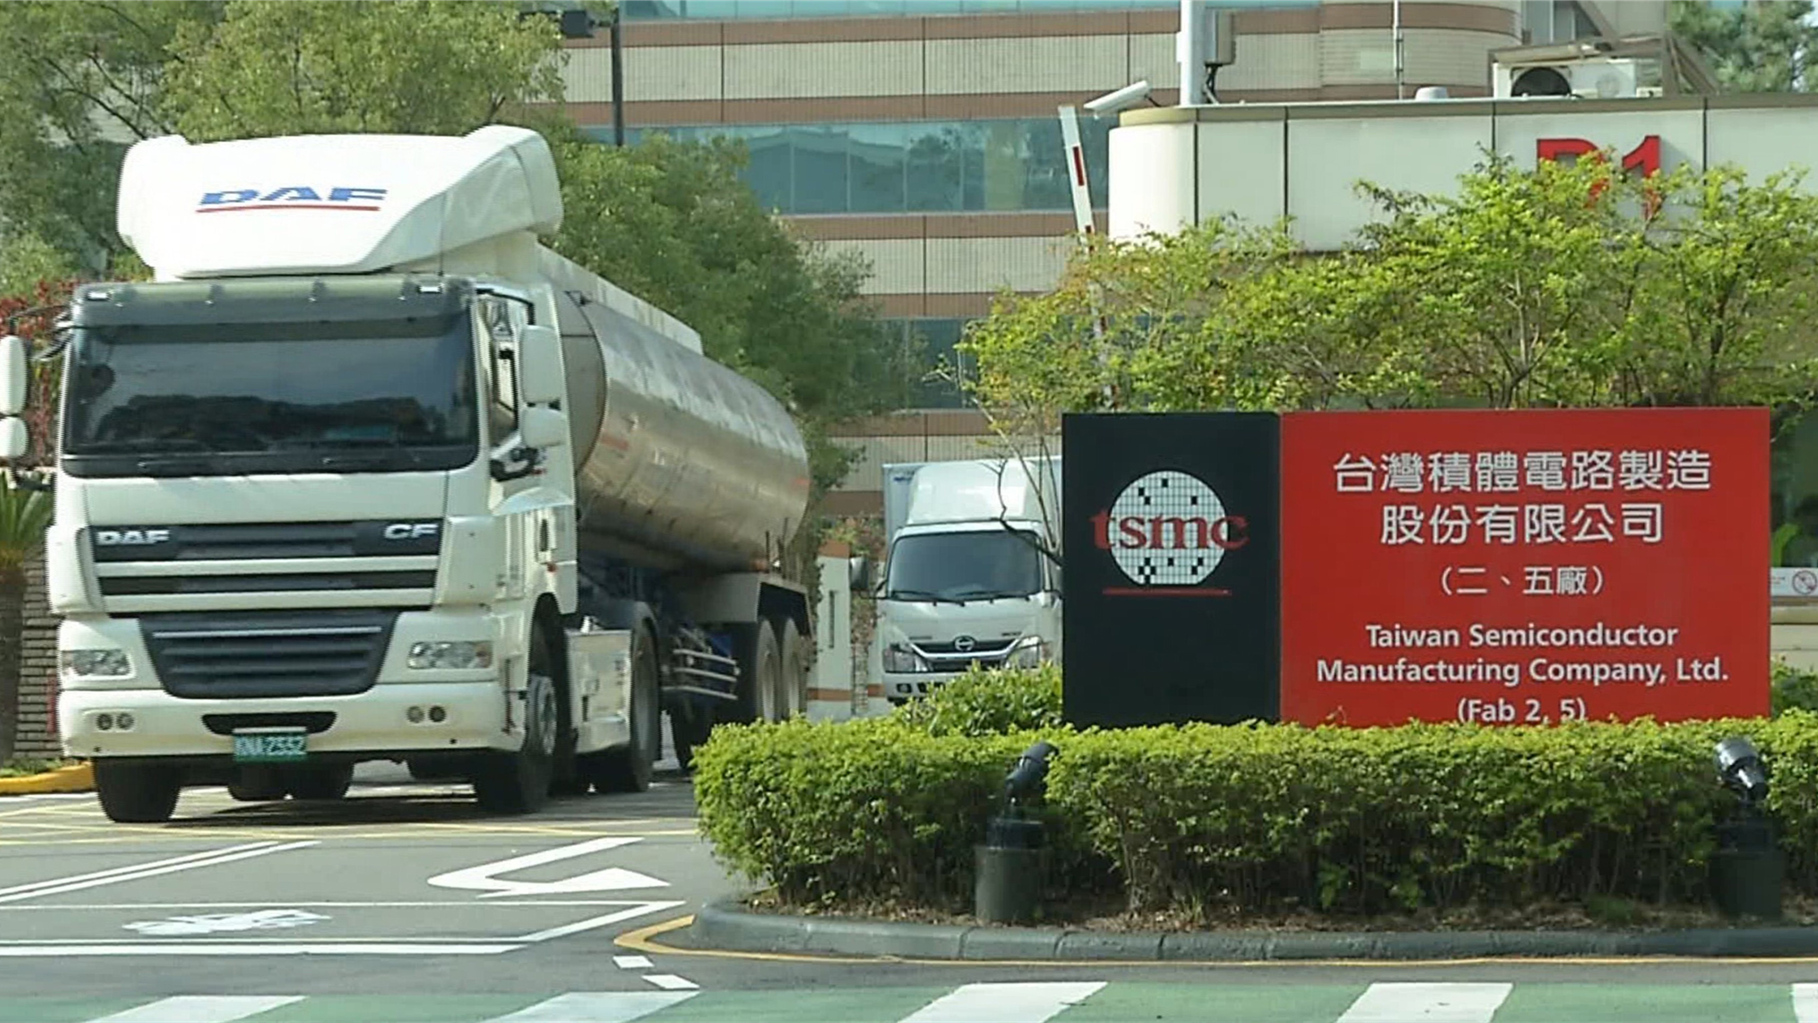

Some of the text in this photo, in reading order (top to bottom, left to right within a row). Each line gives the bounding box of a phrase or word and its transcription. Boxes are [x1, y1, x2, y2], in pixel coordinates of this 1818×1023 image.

[200, 186, 387, 206] DAF
[1333, 450, 1712, 493] 台灣積體電路製造
[98, 529, 170, 545] DAF
[384, 523, 438, 540] CF
[1089, 508, 1250, 551] tsmc
[1380, 503, 1663, 545] 股份有限公司
[1365, 621, 1679, 648] Taiwan Semiconductor
[1317, 656, 1729, 687] Manufacturing Company, Ltd.
[1458, 697, 1587, 725] (Fab 2, 5)
